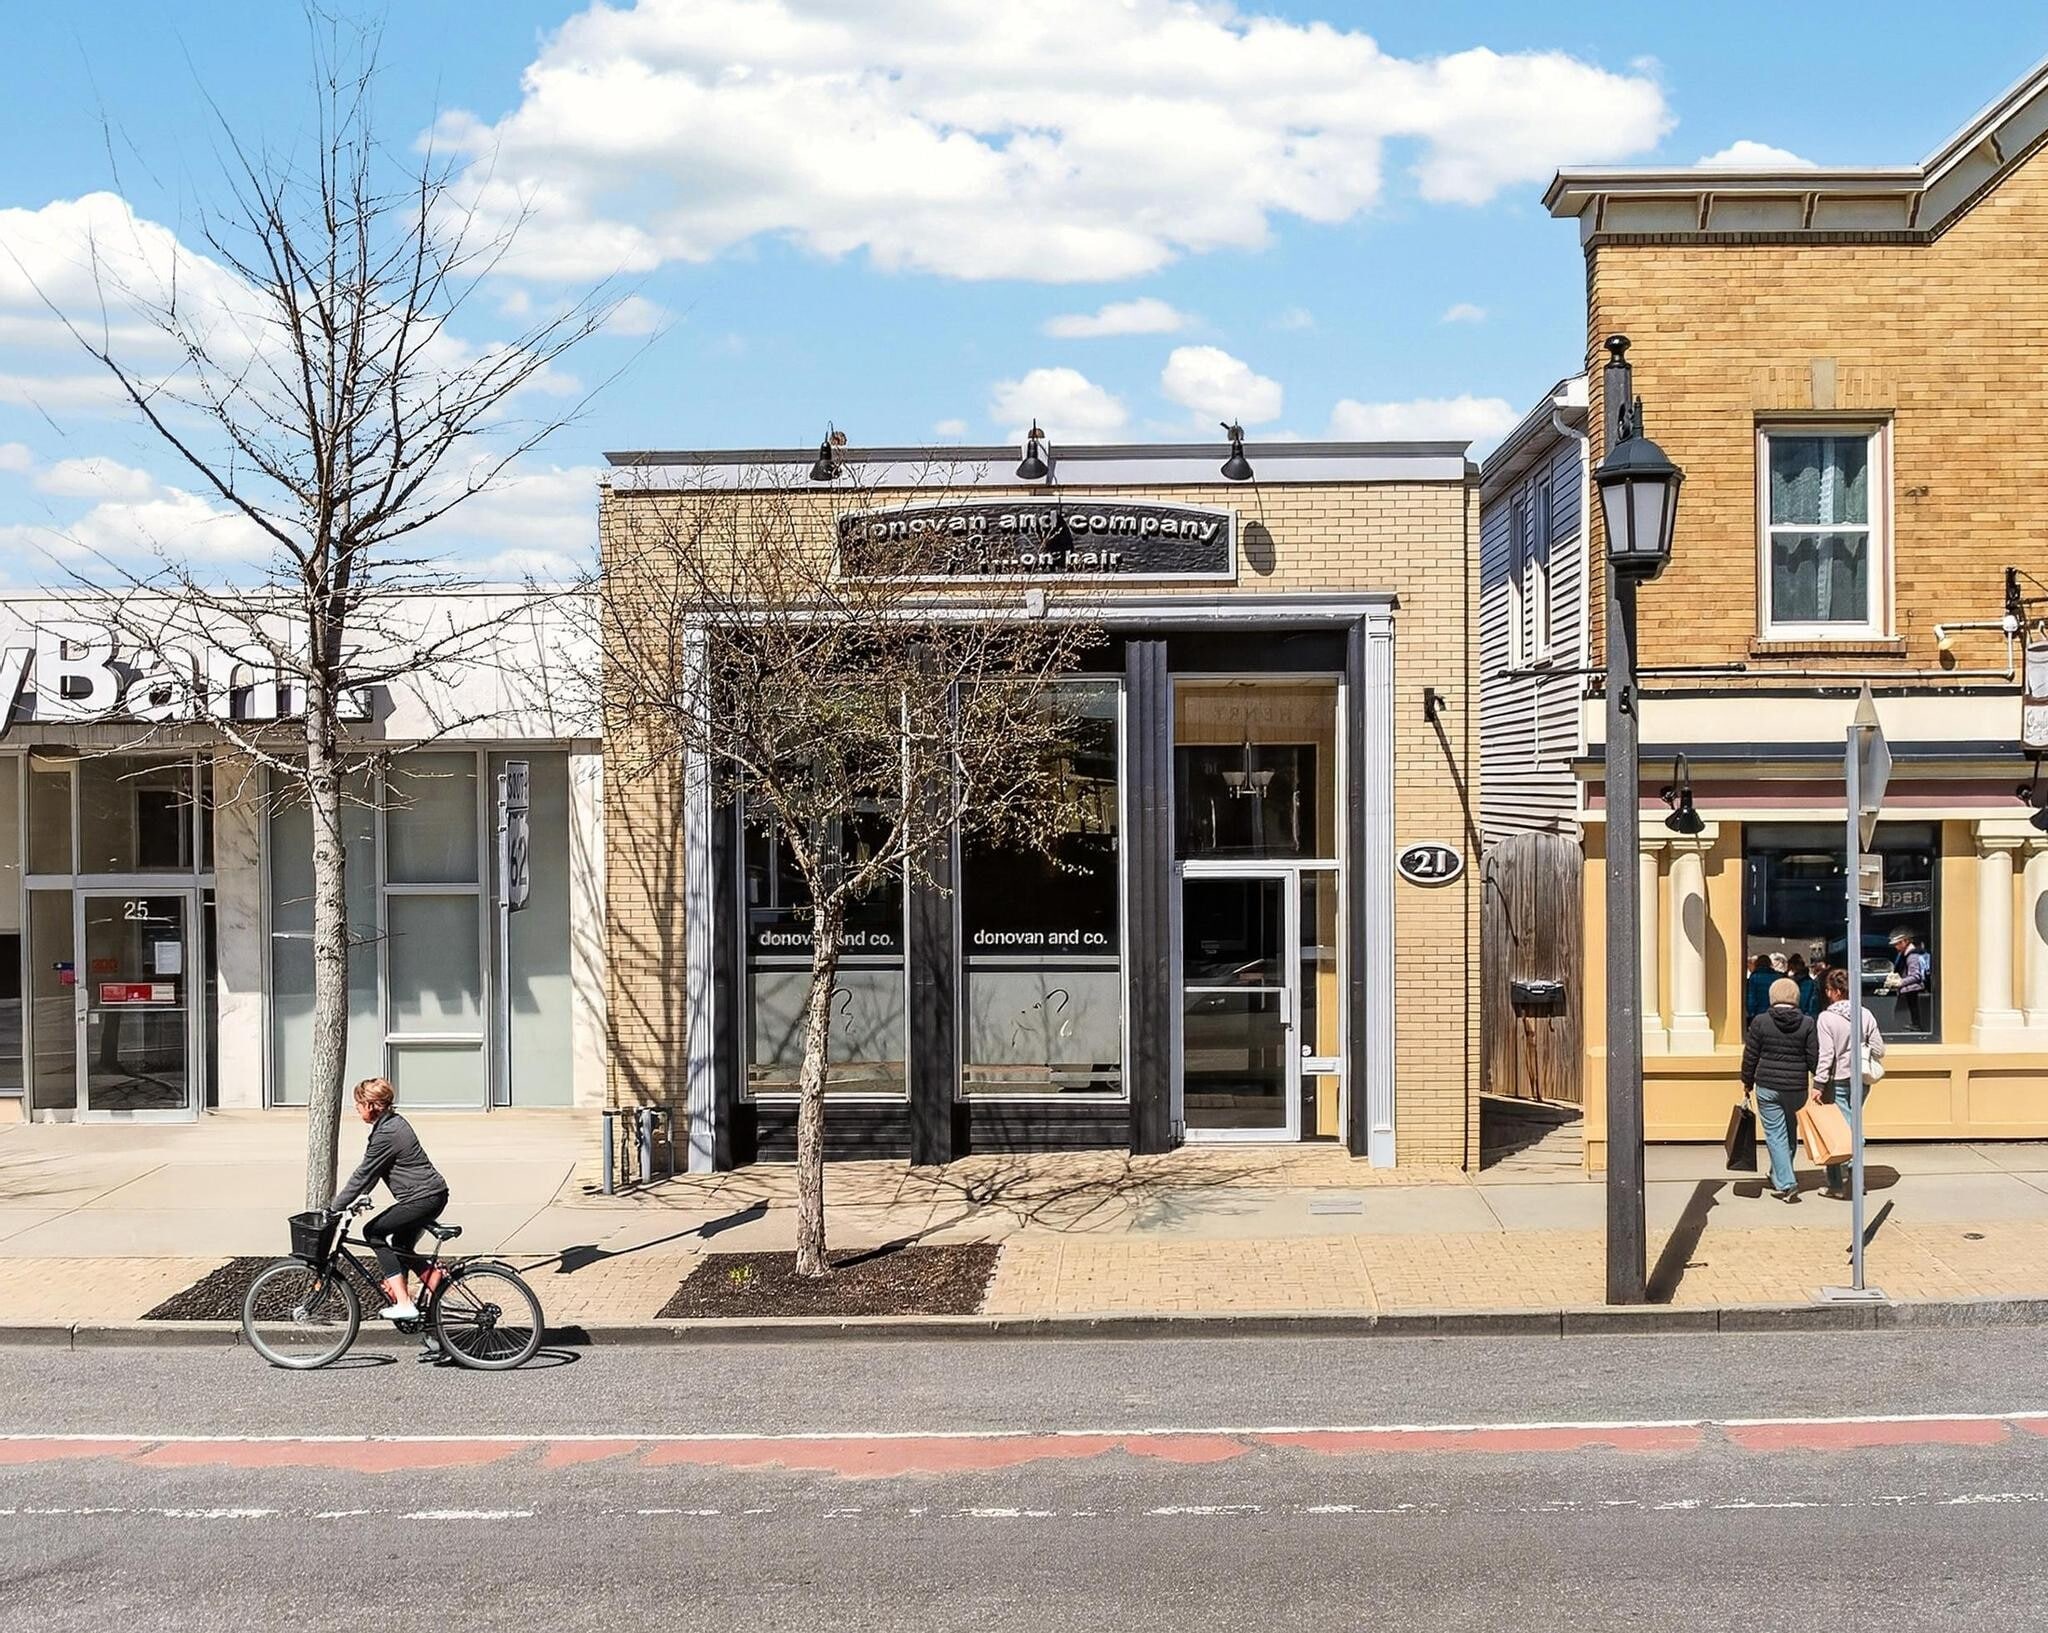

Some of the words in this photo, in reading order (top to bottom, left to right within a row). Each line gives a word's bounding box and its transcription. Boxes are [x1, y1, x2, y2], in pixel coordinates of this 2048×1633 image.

[856, 514, 987, 539] onovan
[999, 510, 1058, 530] and
[1069, 514, 1218, 540] company
[1066, 550, 1121, 565] hair
[510, 836, 527, 887] 62
[1413, 850, 1447, 873] 21
[124, 901, 148, 920] 25
[760, 930, 813, 946] donov
[843, 930, 866, 946] nd
[870, 933, 895, 946] co.
[973, 929, 1044, 945] donovan
[1048, 929, 1079, 945] and
[1083, 932, 1108, 945] co.
